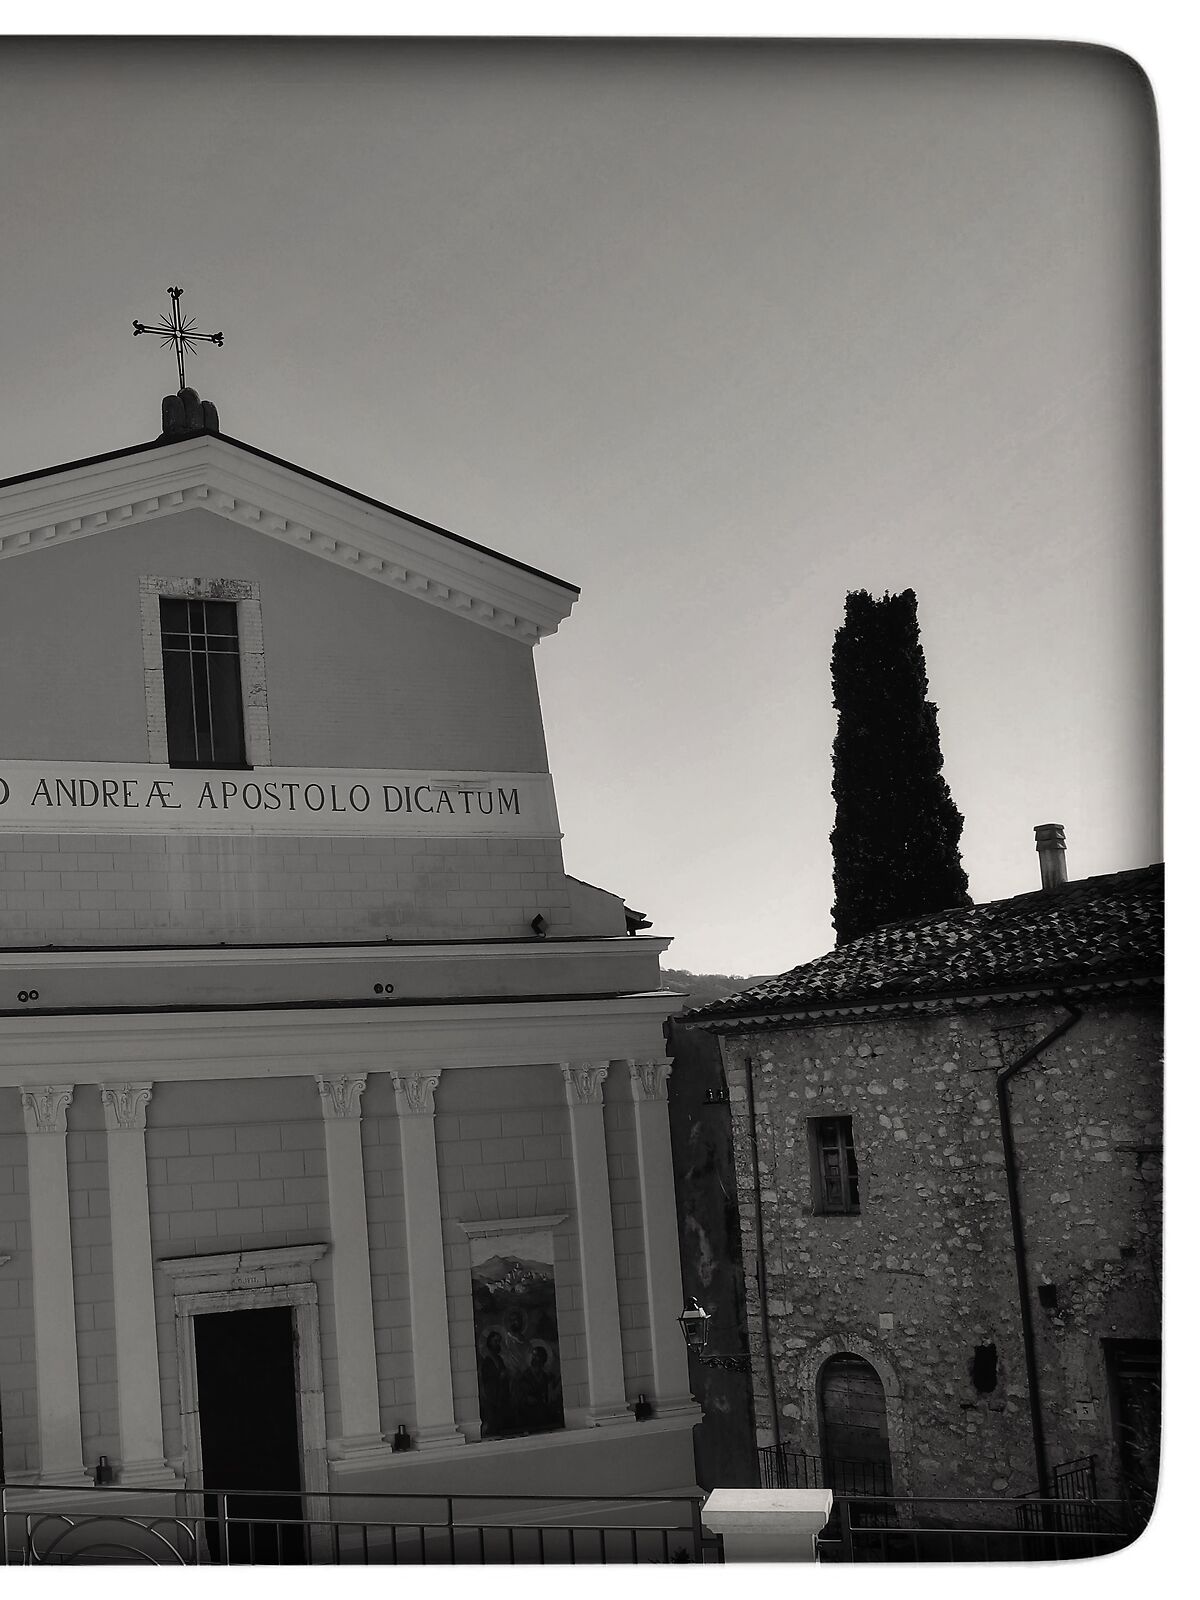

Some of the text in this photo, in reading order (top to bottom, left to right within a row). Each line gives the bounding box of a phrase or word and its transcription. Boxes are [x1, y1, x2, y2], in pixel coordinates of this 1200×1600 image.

[30, 778, 182, 809] ANDREÆ
[197, 781, 370, 812] APOSTOLO
[383, 785, 520, 815] DICATUM
